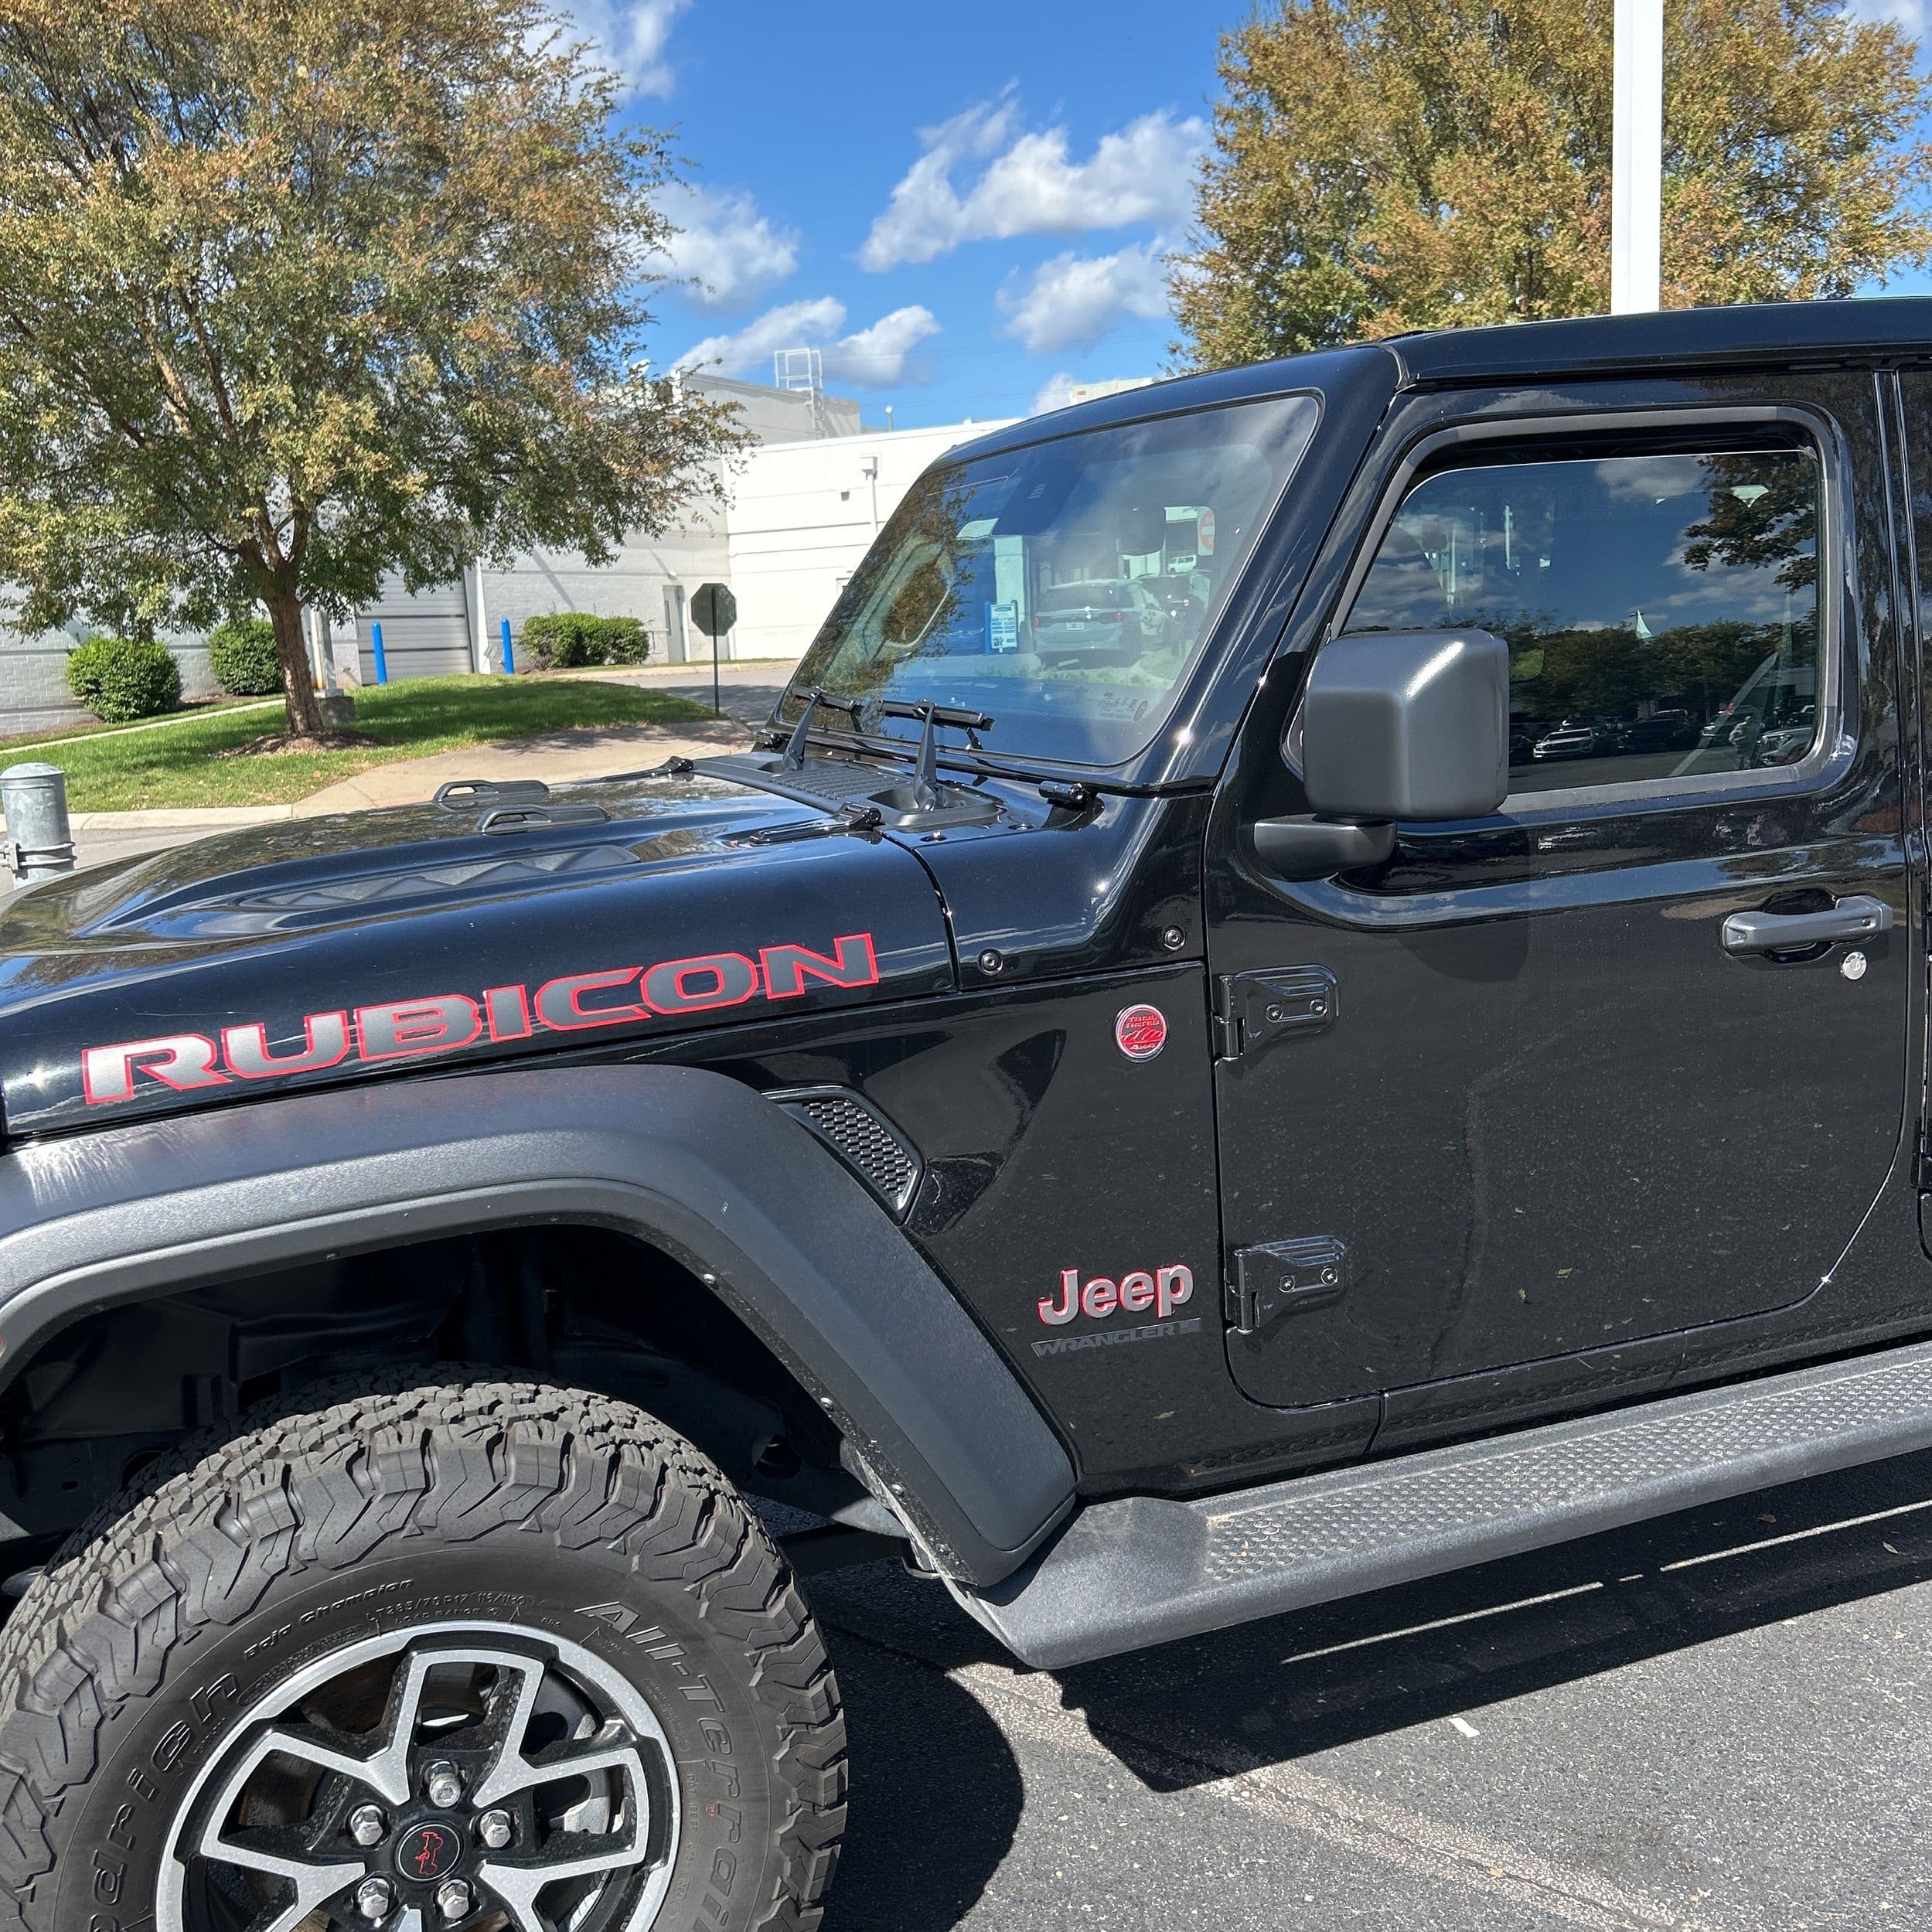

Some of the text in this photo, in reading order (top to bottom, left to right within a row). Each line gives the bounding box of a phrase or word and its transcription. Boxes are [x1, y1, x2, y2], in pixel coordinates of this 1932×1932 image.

[83, 932, 880, 1105] RUBICON
[1037, 1264, 1194, 1327] Jeep
[1035, 1324, 1176, 1354] WRANGLER
[244, 1624, 292, 1661] Baja
[298, 1579, 415, 1624] Champion
